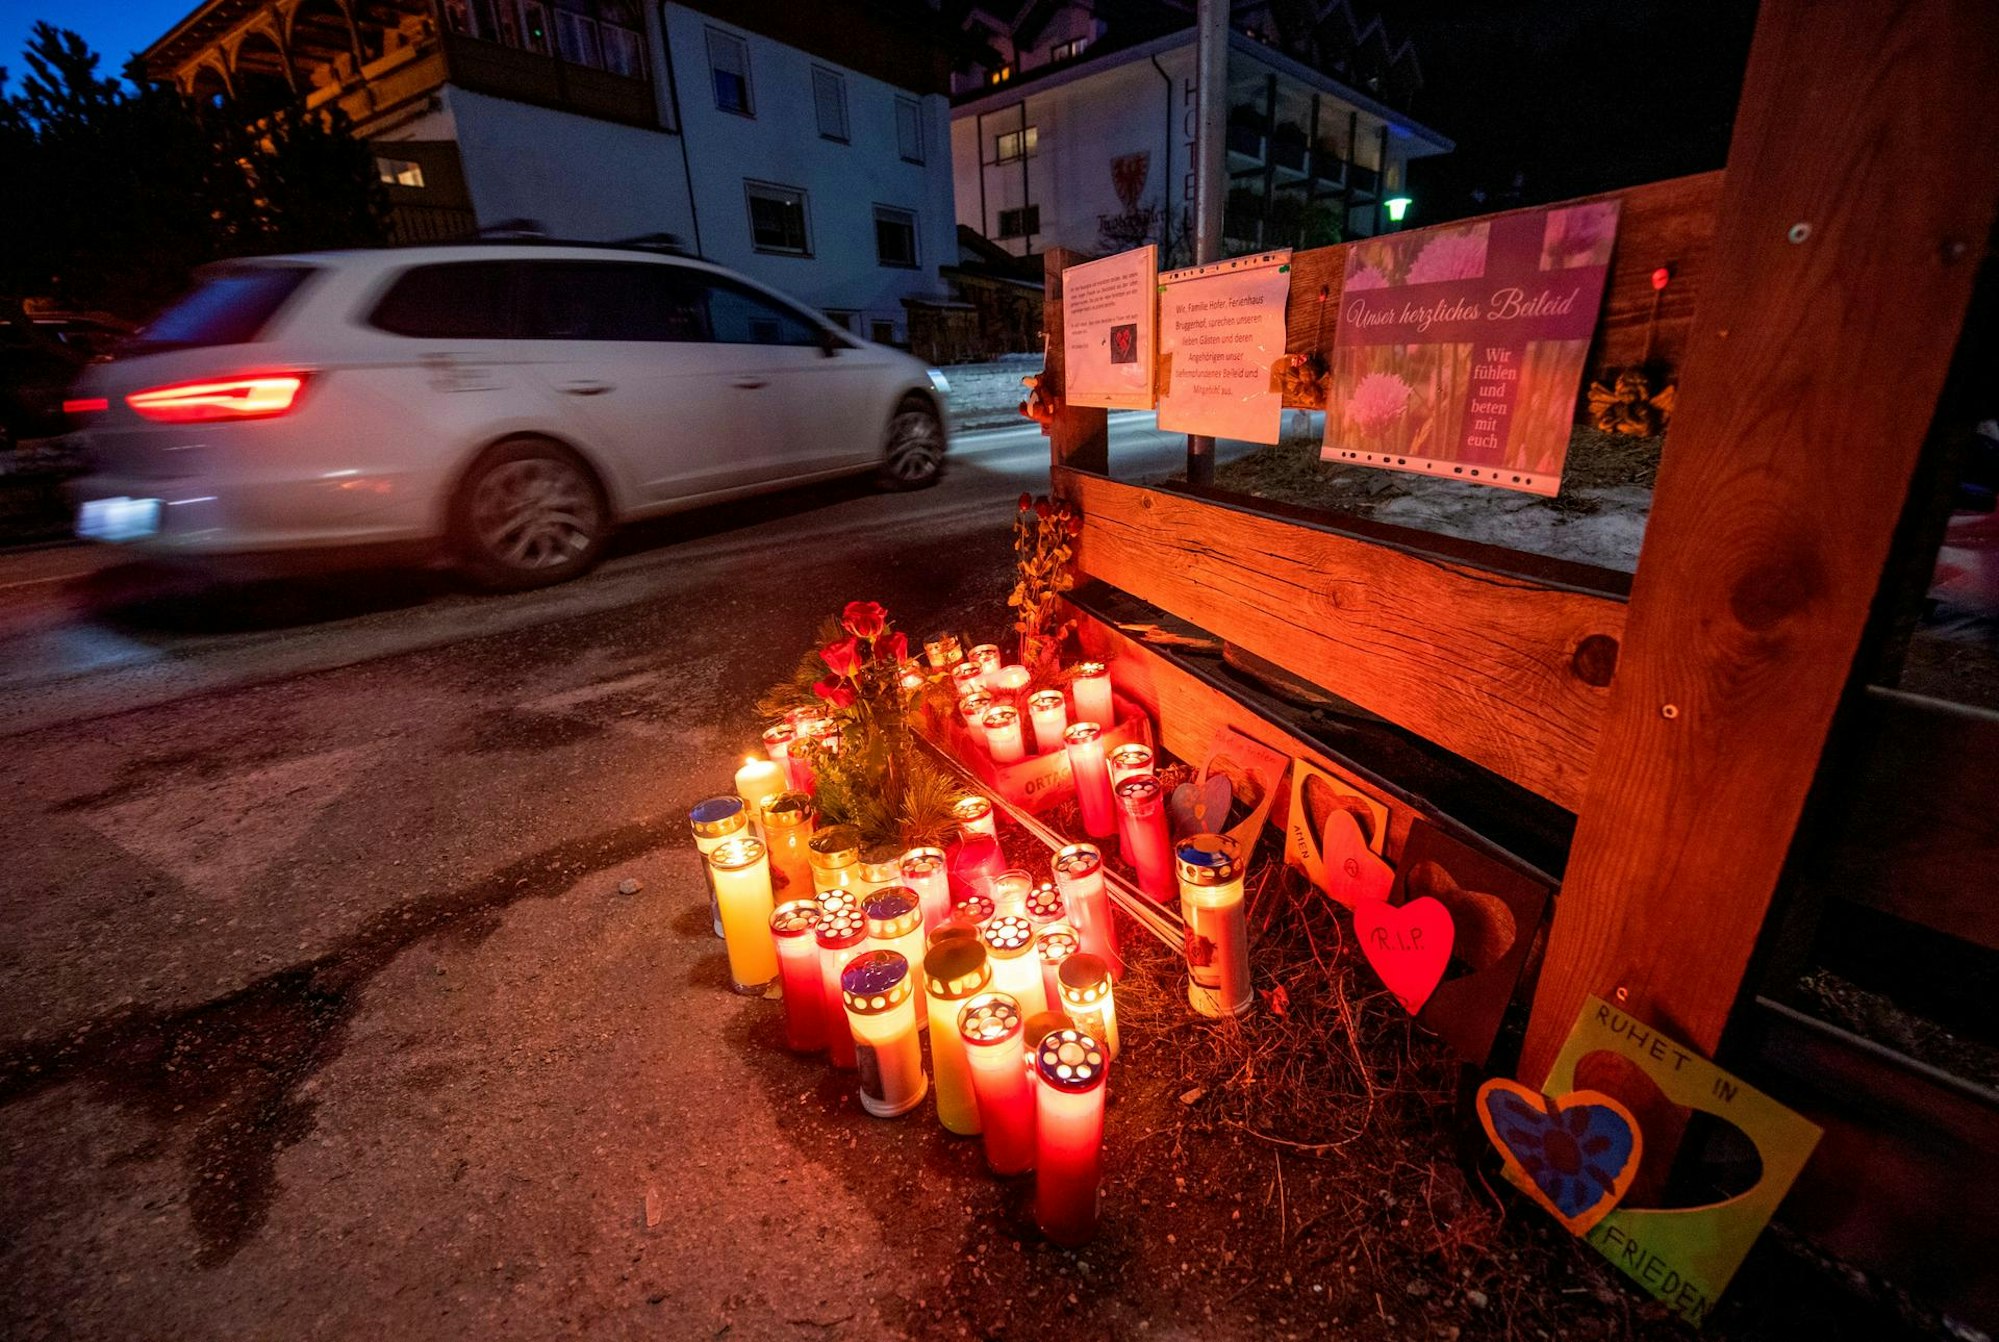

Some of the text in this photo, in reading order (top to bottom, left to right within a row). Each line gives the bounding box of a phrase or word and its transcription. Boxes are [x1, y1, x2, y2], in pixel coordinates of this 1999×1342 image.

[1188, 302, 1208, 312] Familie
[1229, 295, 1264, 308] Ferienhaus
[1347, 287, 1581, 333] Unser herzliches Beileid
[1208, 317, 1235, 329] sprechen
[1237, 314, 1262, 325] unseren
[1199, 335, 1220, 346] Gästen
[1222, 335, 1233, 344] und
[1234, 334, 1253, 343] deren
[1188, 352, 1244, 364] Angehörigen unser
[1486, 347, 1512, 362] Wir
[1222, 368, 1244, 378] Beileid
[1245, 368, 1259, 378] und
[1473, 364, 1517, 380] fühlen
[1479, 382, 1506, 397] und
[1471, 398, 1508, 415] beten
[1474, 416, 1497, 431] mit
[1467, 433, 1498, 449] euch
[1293, 825, 1310, 859] AMEN
[1595, 1004, 1739, 1103] RUHET IN
